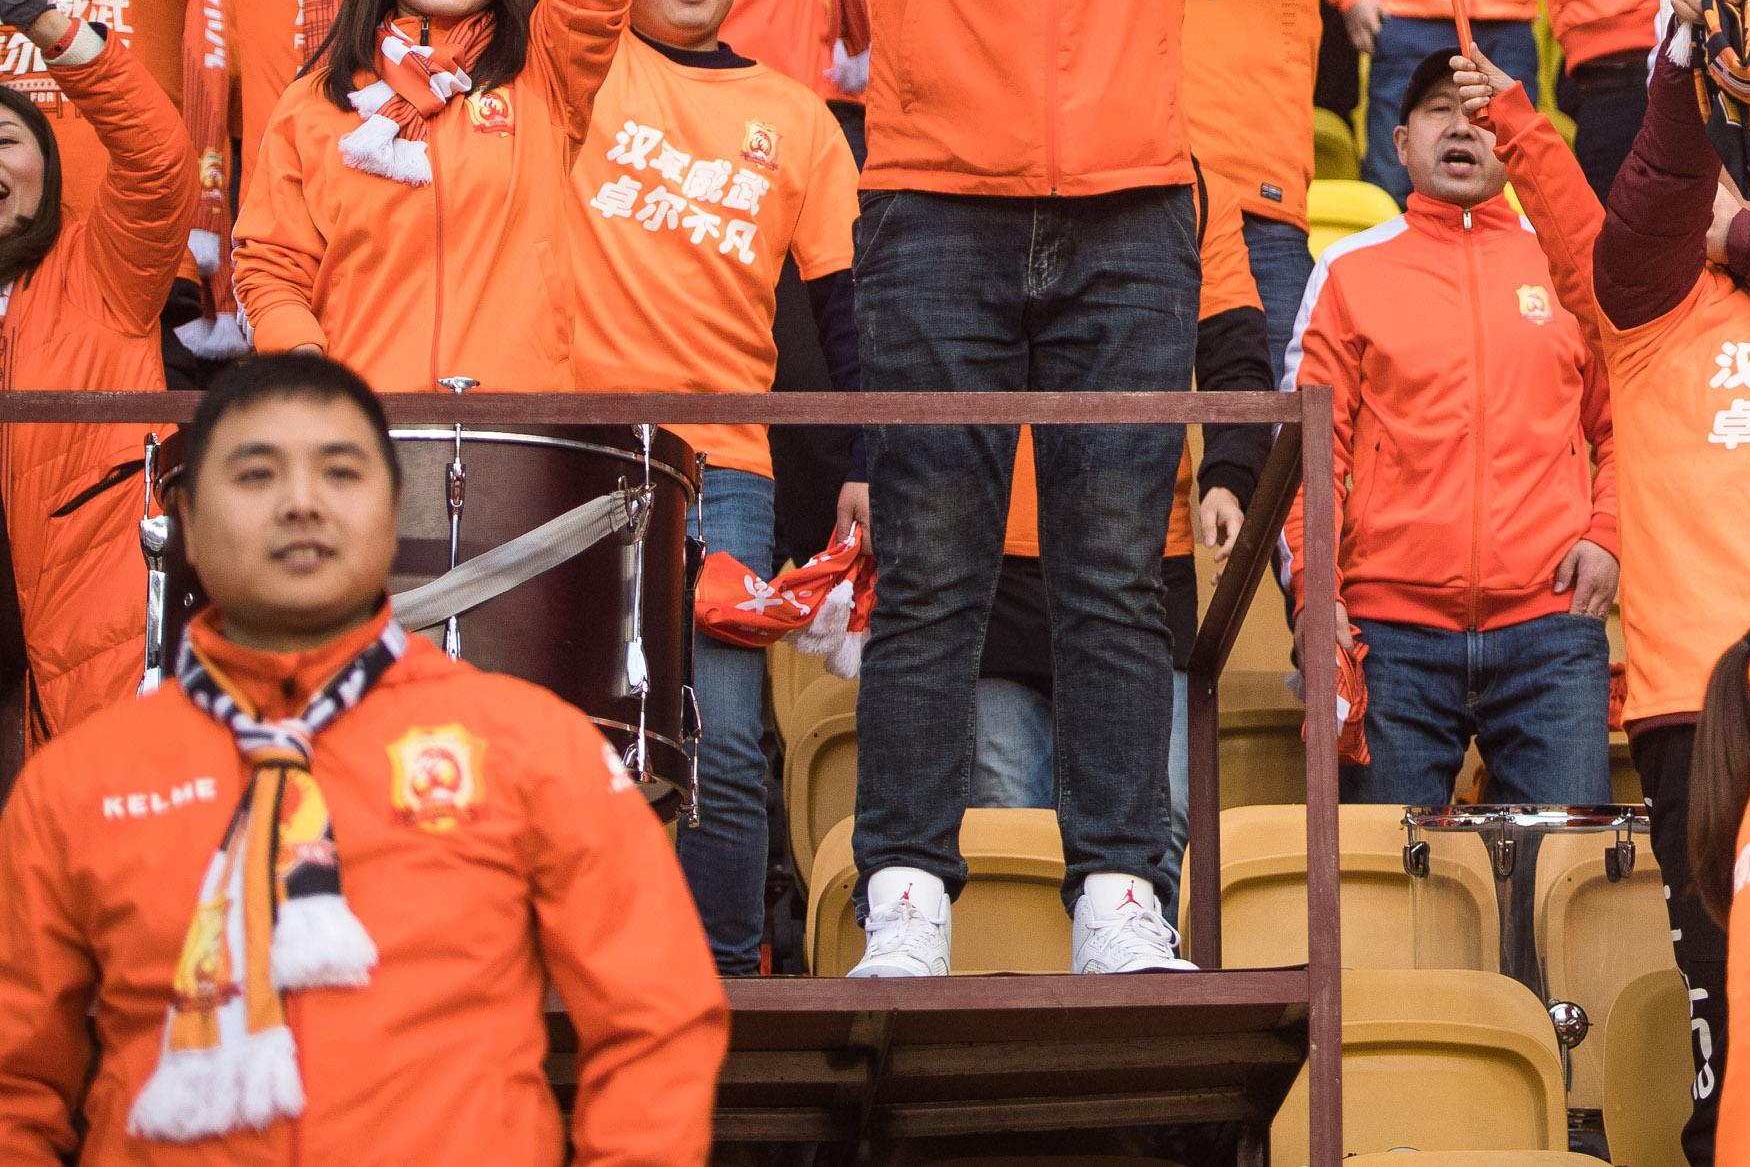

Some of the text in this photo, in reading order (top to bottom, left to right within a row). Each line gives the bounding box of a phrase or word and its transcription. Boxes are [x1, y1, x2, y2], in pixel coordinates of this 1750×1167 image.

[606, 119, 771, 218] 汉军威武
[589, 174, 758, 265] 卓尔不凡
[102, 777, 217, 820] KELME
